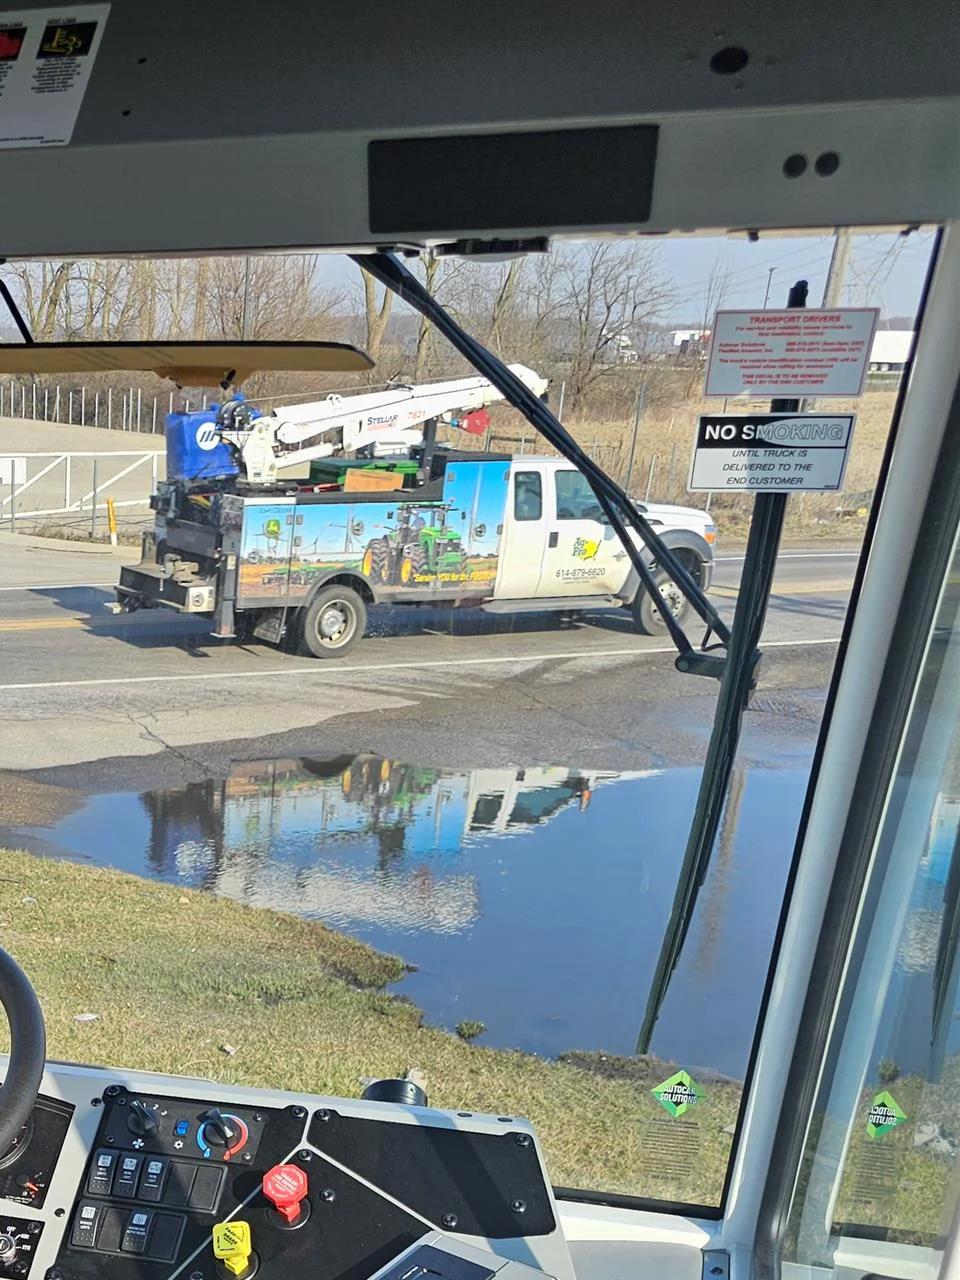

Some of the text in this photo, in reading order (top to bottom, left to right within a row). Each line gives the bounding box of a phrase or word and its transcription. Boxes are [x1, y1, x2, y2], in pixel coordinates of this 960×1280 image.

[750, 315, 841, 324] TRANSPORT DRIVERS
[367, 415, 399, 426] STELLAR
[705, 424, 844, 440] NO SMOKING
[732, 449, 808, 458] UNTIL TRUCK IS
[722, 463, 814, 472] DELIVERED TO THE
[726, 477, 804, 485] END CUSTOMER
[663, 1085, 696, 1095] AUTOCAR
[659, 1092, 698, 1104] SOLUTIONS
